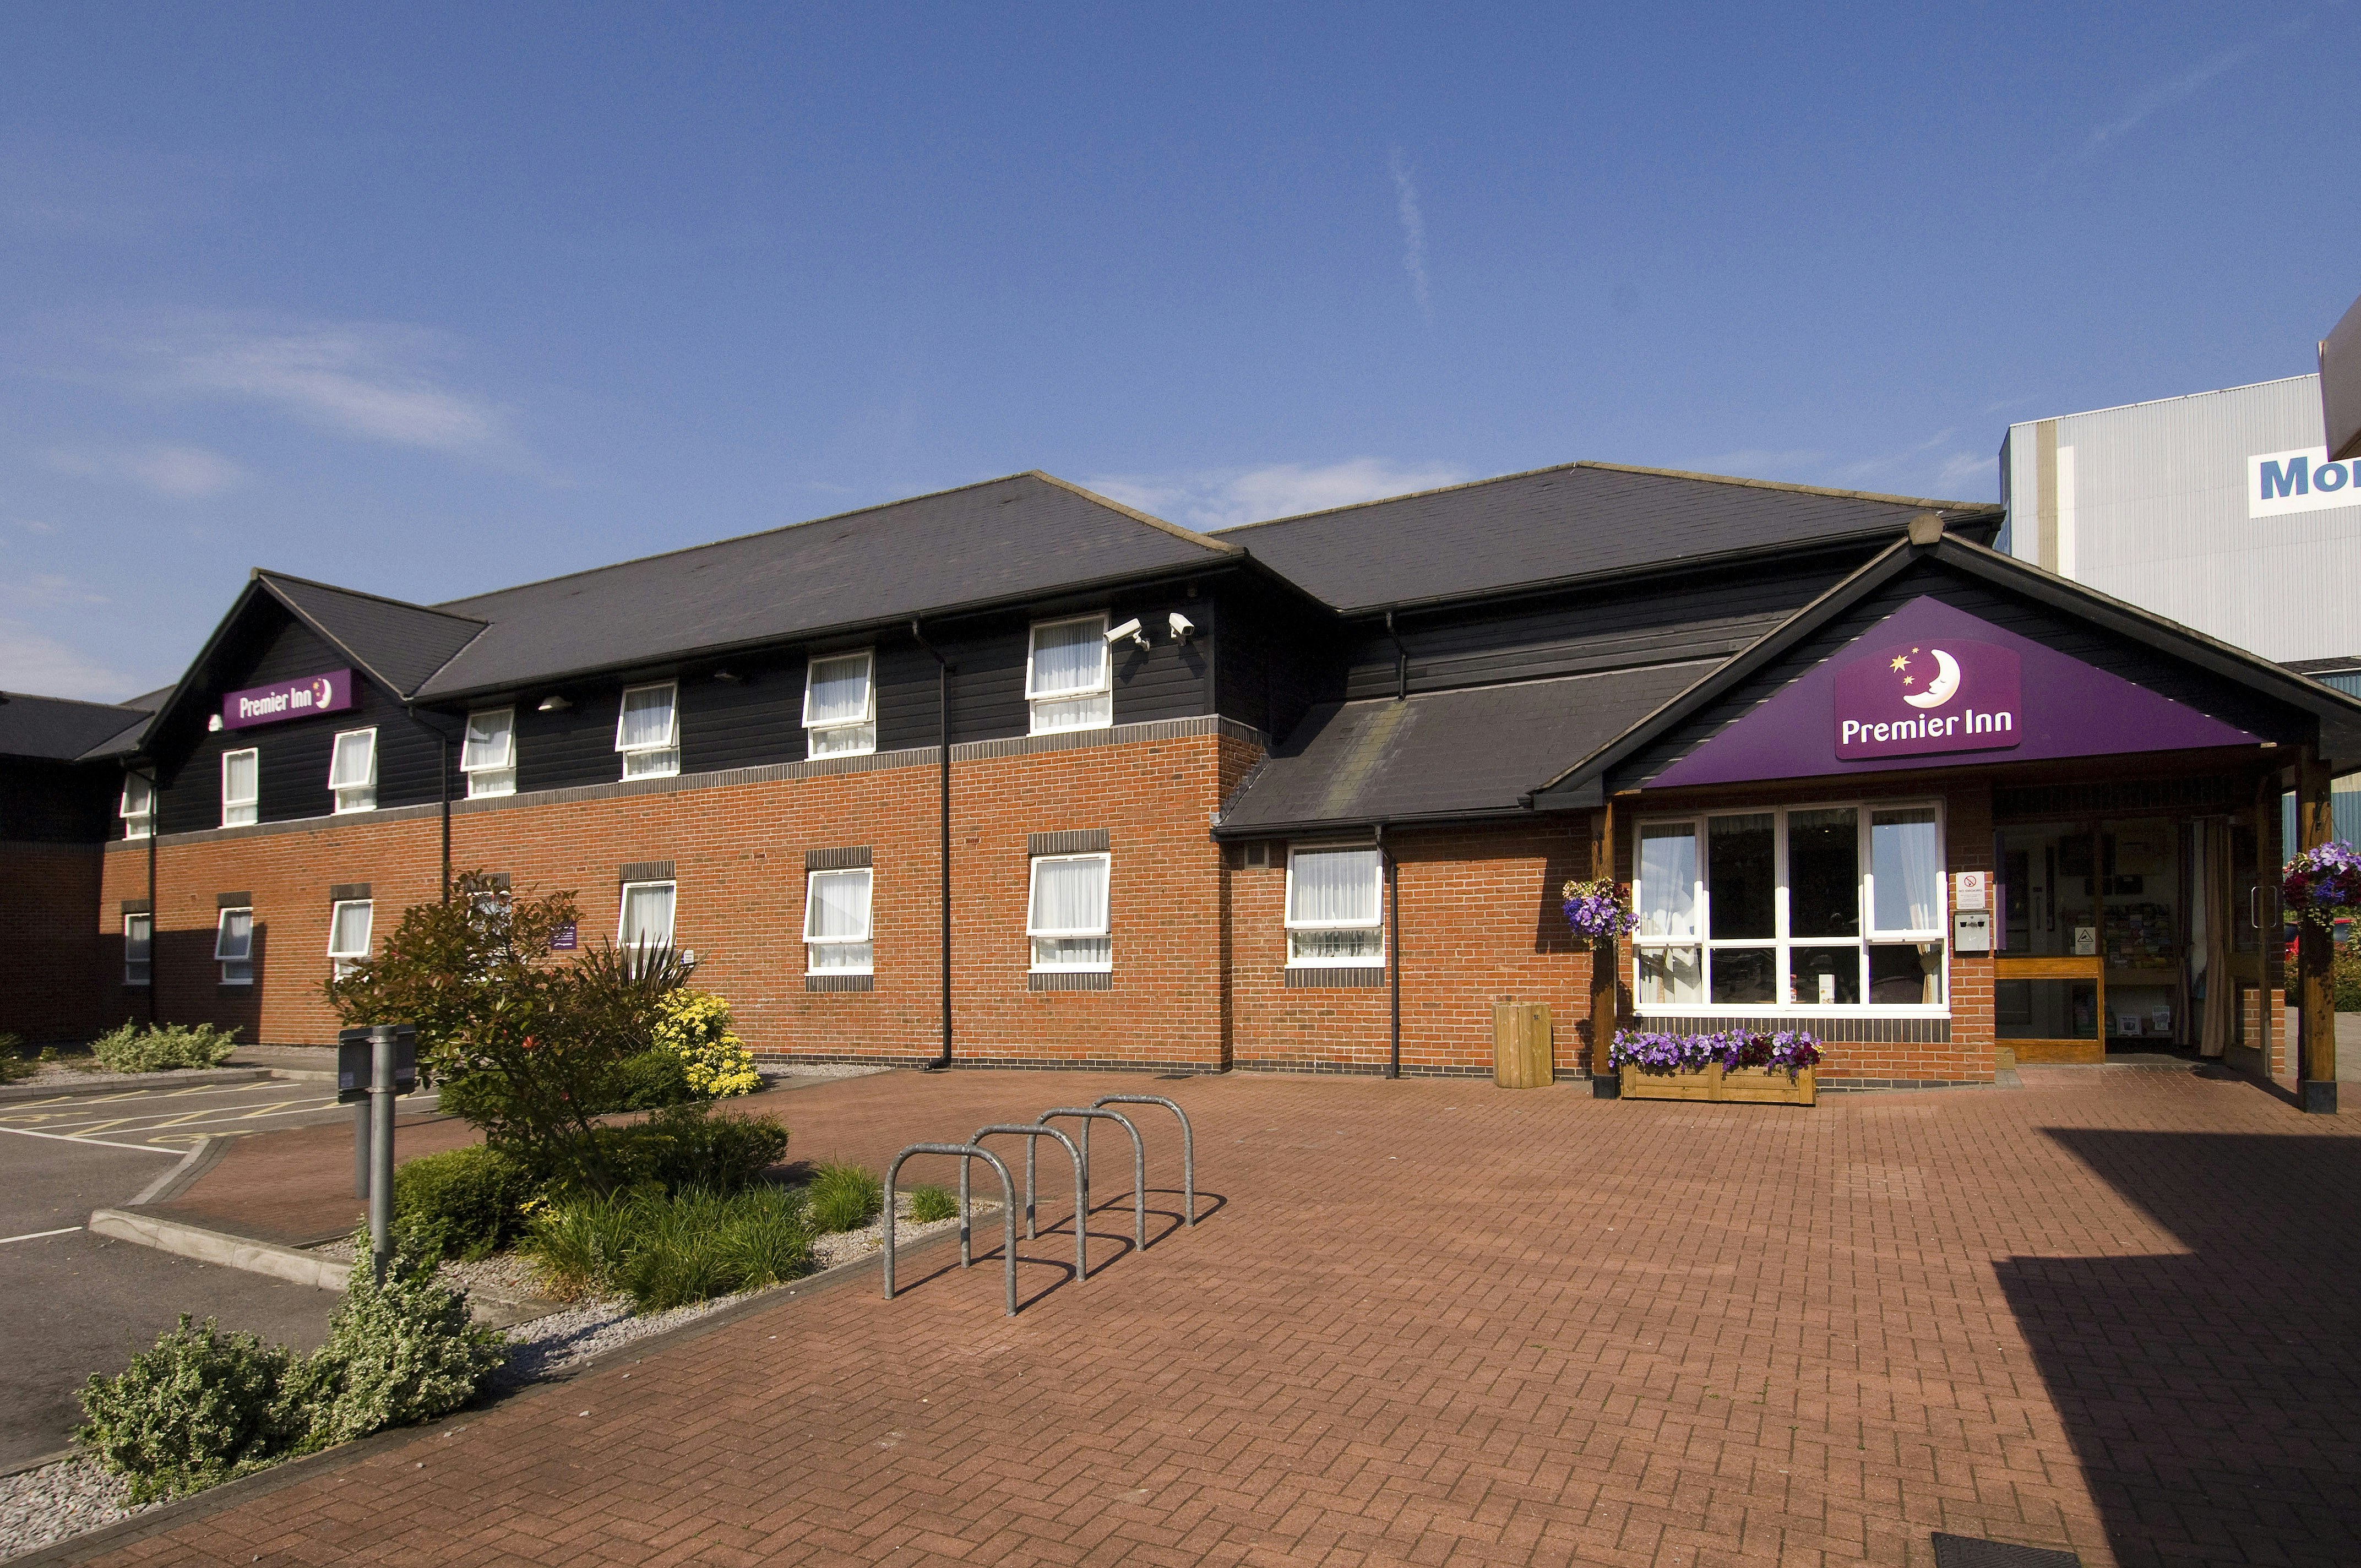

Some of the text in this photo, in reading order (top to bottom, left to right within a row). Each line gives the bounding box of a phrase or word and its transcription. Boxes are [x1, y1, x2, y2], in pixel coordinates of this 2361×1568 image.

[240, 687, 312, 718] Premier Inn
[1842, 709, 2011, 744] Premier Inn
